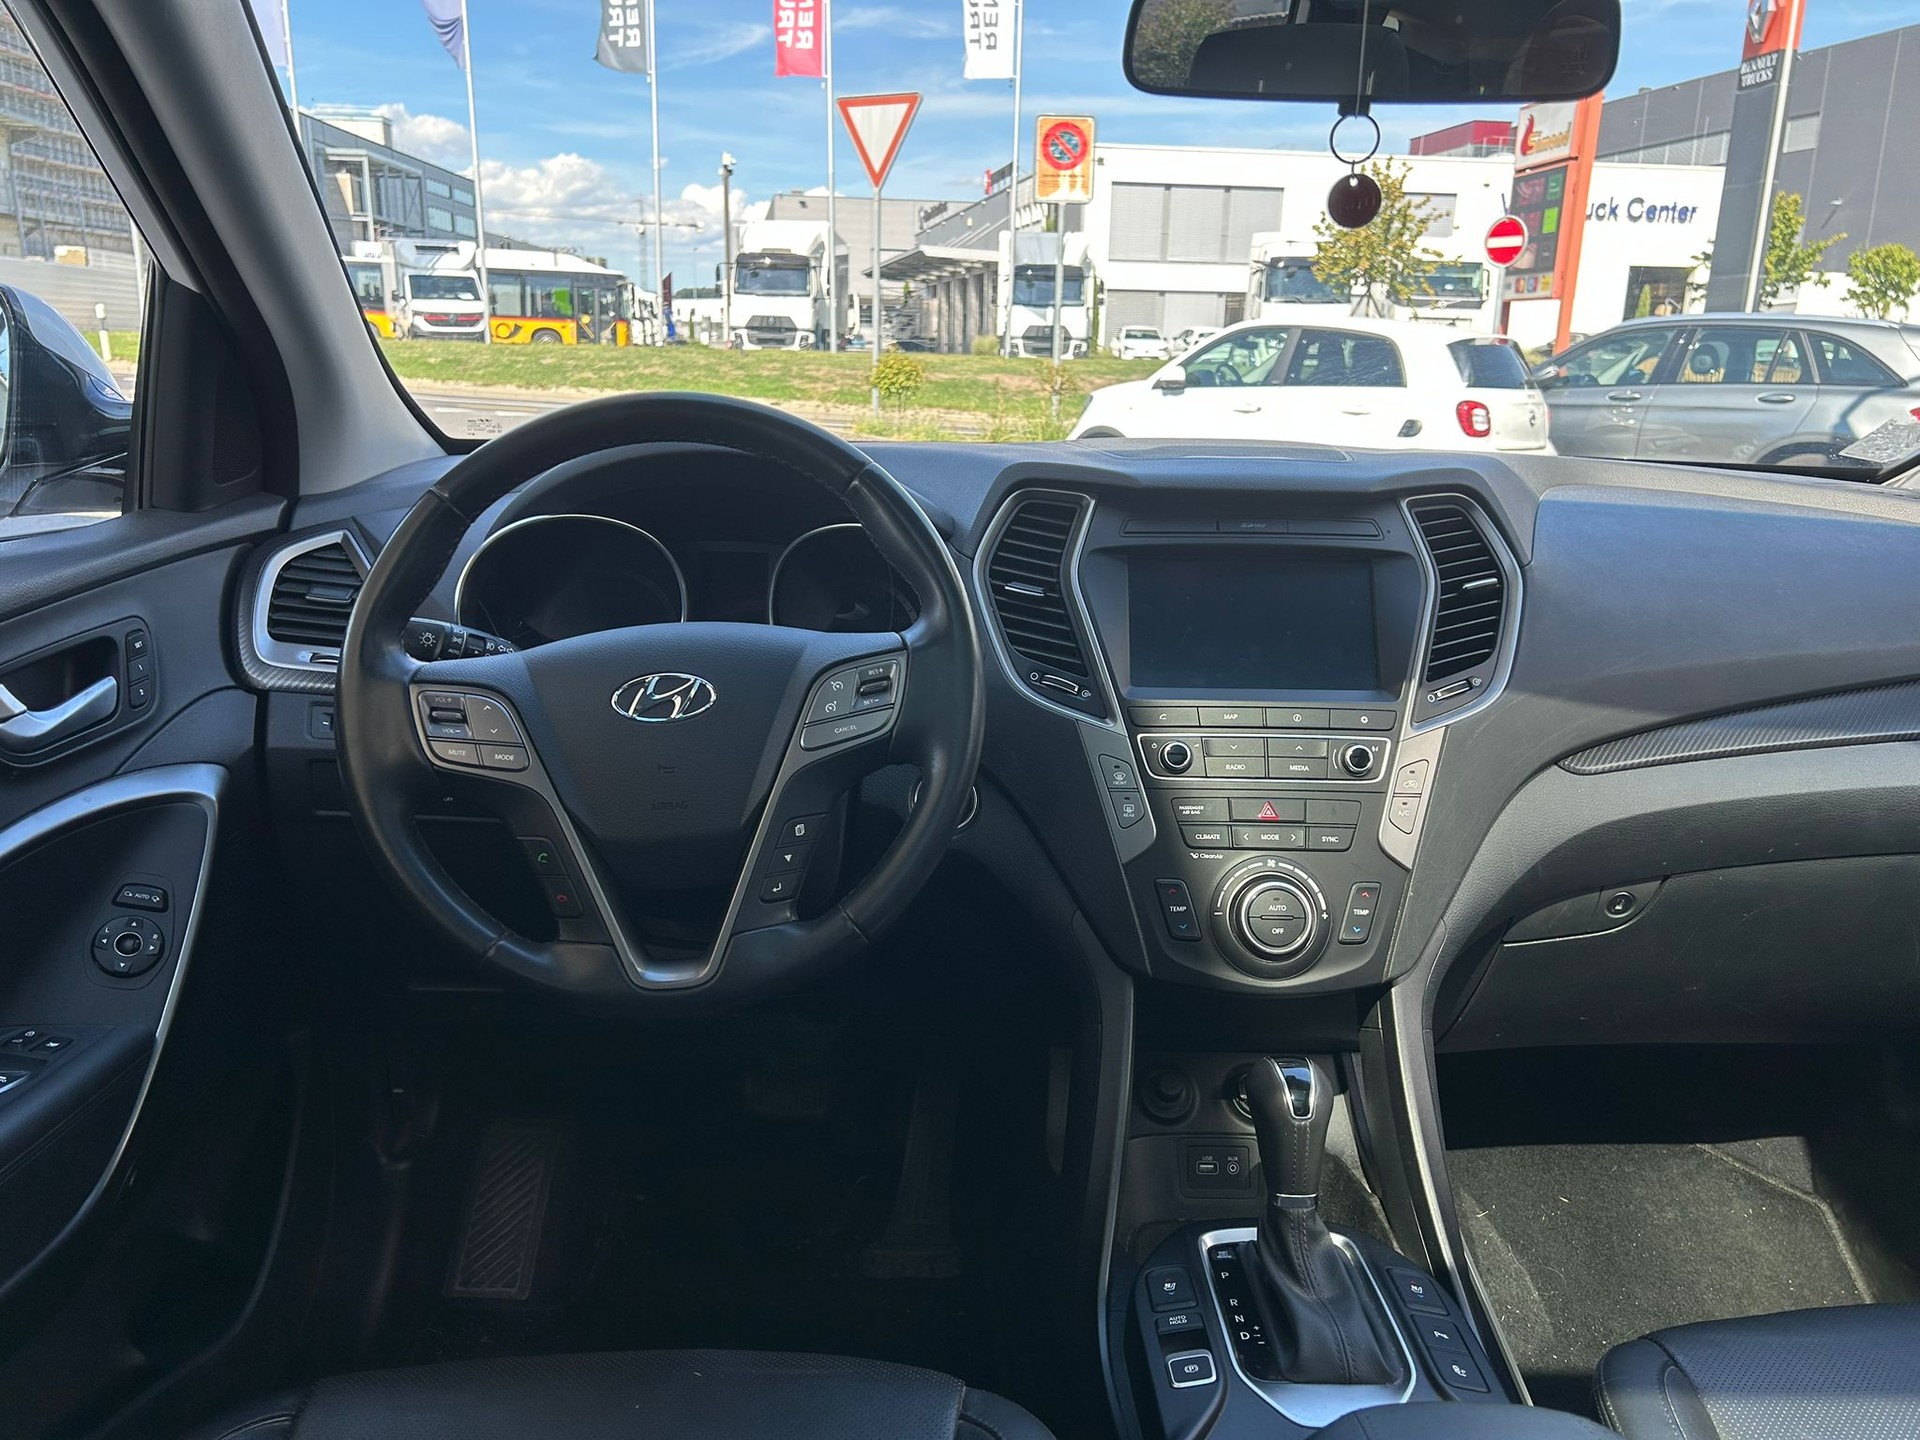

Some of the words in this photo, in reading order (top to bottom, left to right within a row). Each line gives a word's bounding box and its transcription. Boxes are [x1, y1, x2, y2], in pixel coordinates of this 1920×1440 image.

[1586, 196, 1620, 222] uck
[1626, 197, 1698, 224] Center
[834, 724, 858, 734] CANCEL
[447, 749, 467, 757] MUTE
[494, 753, 515, 761] MODE
[1260, 833, 1280, 841] MODE
[134, 892, 150, 900] AUTO
[1268, 904, 1288, 912] AUTO
[1271, 927, 1285, 935] OFF
[1220, 1271, 1230, 1279] P
[1229, 1299, 1239, 1307] R
[1168, 1314, 1186, 1322] AUTO
[1234, 1314, 1245, 1323] N
[1240, 1331, 1251, 1340] D
